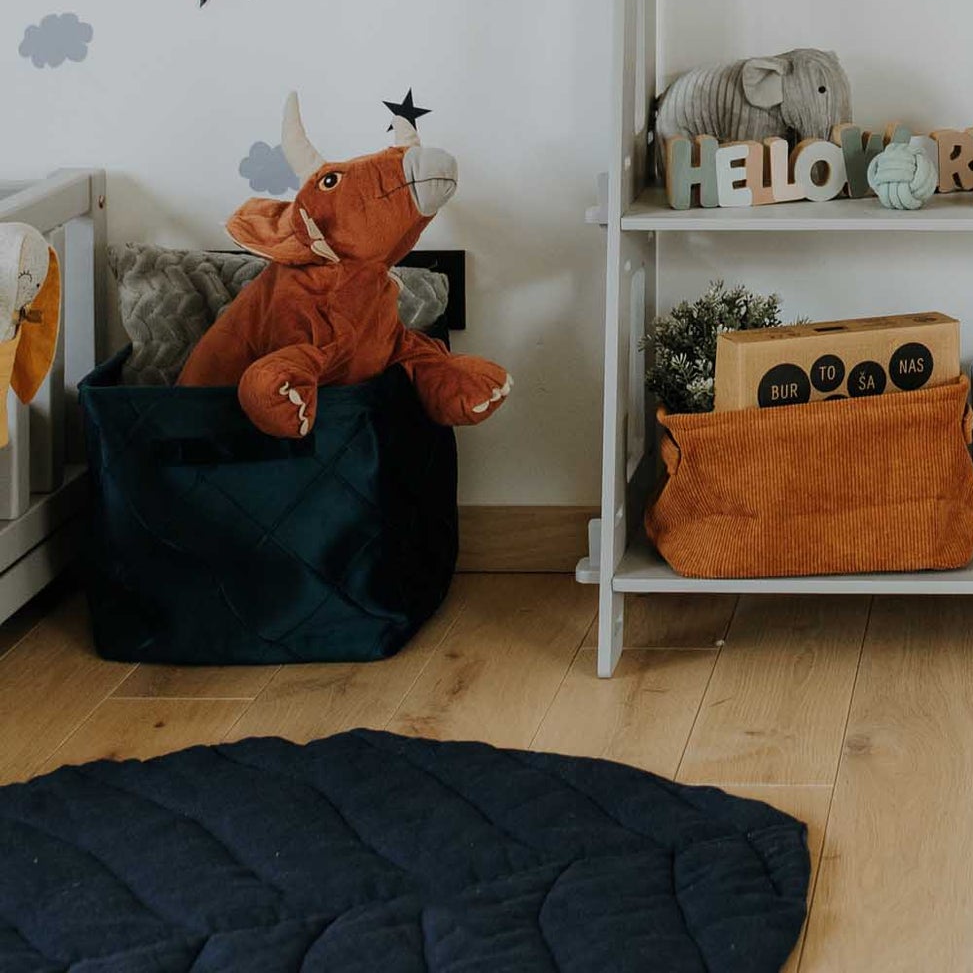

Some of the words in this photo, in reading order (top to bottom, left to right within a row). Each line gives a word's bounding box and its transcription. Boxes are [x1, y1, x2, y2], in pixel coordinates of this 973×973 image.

[668, 134, 848, 210] HELLO
[771, 383, 799, 401] BUR
[819, 364, 836, 382] TO
[858, 371, 876, 391] ŠA
[899, 356, 925, 375] NAS
